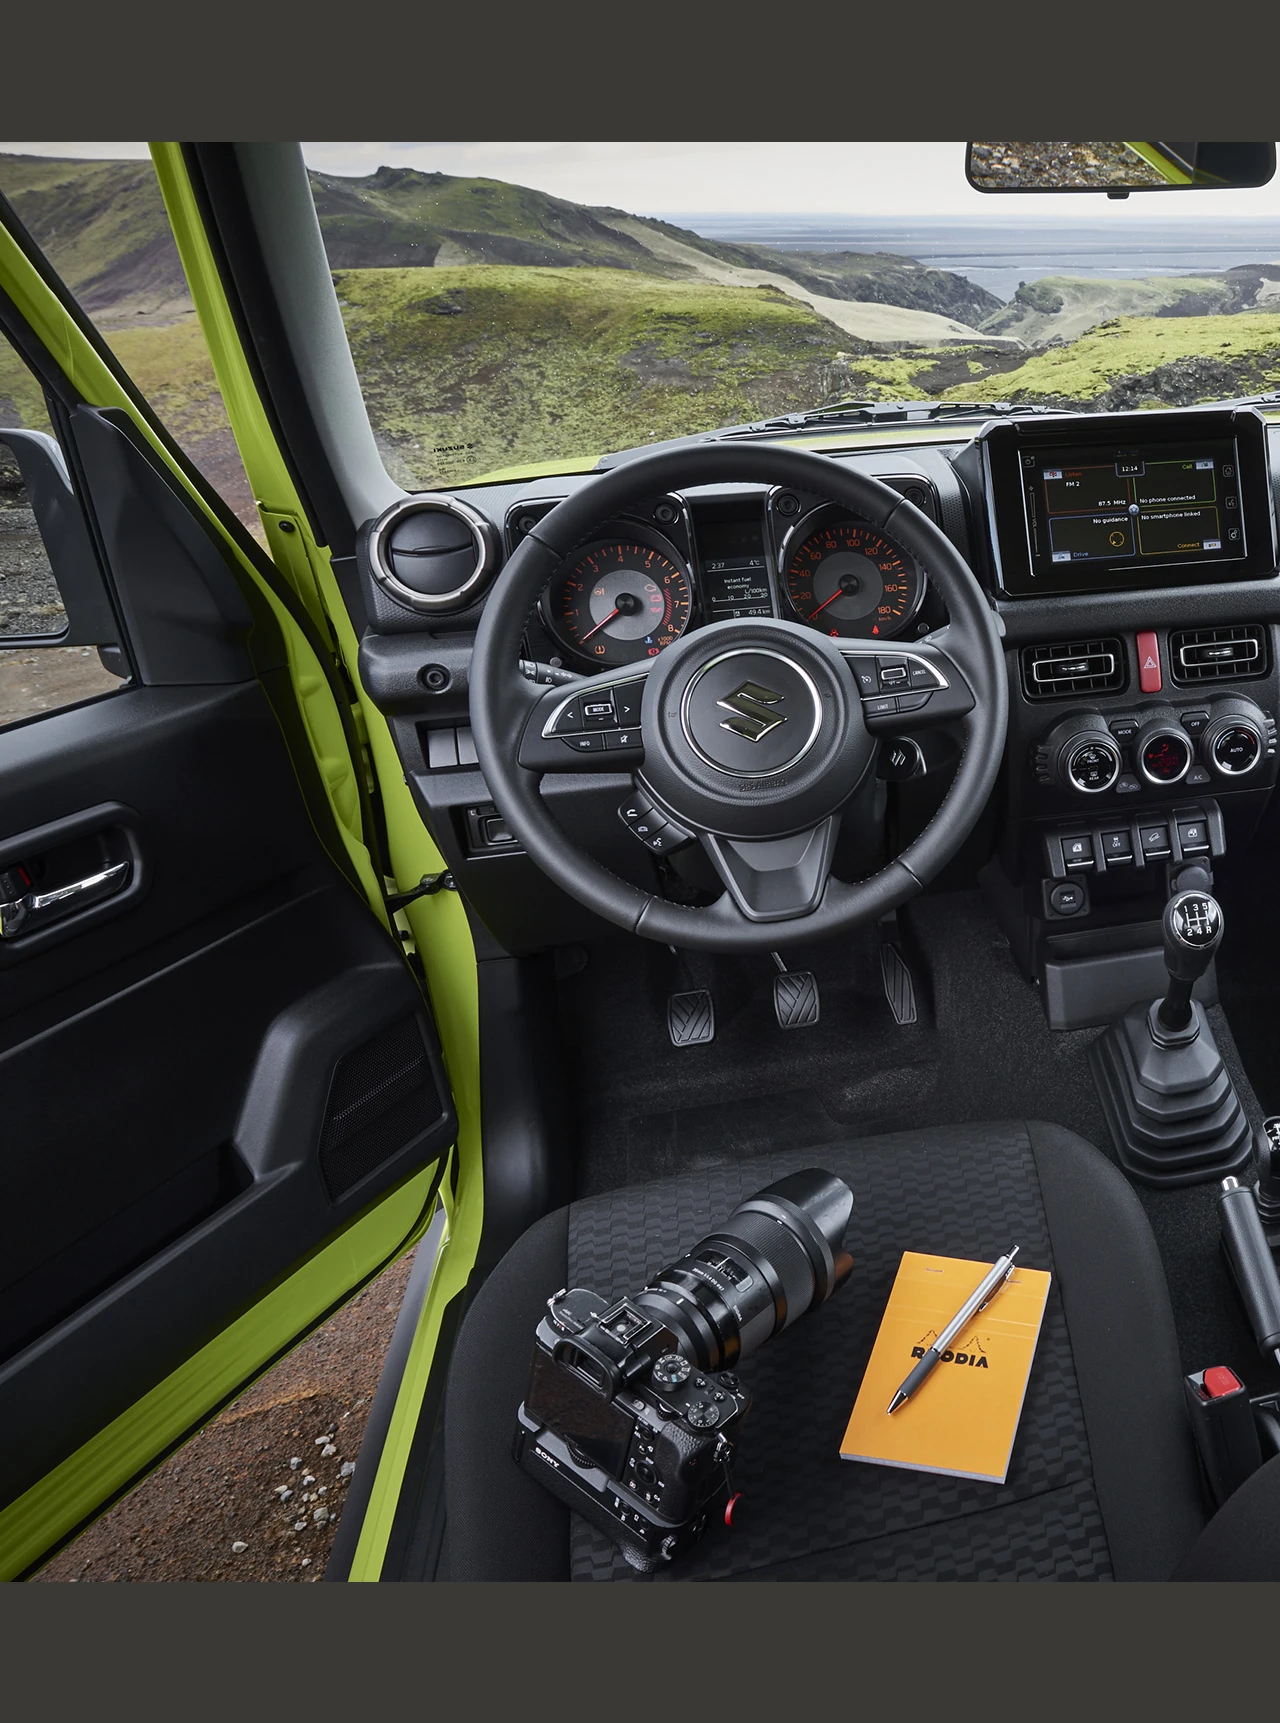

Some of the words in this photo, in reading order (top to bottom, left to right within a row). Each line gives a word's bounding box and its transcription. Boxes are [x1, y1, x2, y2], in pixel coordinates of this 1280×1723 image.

[1148, 496, 1166, 504] phone
[1150, 512, 1183, 520] smartphone
[825, 540, 837, 549] 80
[846, 538, 860, 547] 100
[864, 547, 878, 556] 120
[617, 555, 624, 563] 4
[810, 552, 821, 560] 60
[645, 560, 652, 568] 5
[879, 562, 893, 571] 140
[593, 564, 599, 573] 3
[799, 569, 811, 577] 40
[664, 576, 671, 584] 6
[577, 583, 584, 591] 2
[884, 584, 898, 592] 160
[800, 591, 811, 600] 20
[674, 600, 680, 608] 7
[575, 608, 579, 616] 1
[877, 606, 892, 614] 180
[667, 624, 674, 632] 8
[1192, 903, 1199, 911] 3
[1201, 902, 1208, 910] 5
[1186, 928, 1193, 937] 2
[1196, 927, 1203, 935] 4
[1205, 925, 1212, 934] R
[911, 1346, 989, 1369] RODIA
[535, 1447, 560, 1468] SONY
